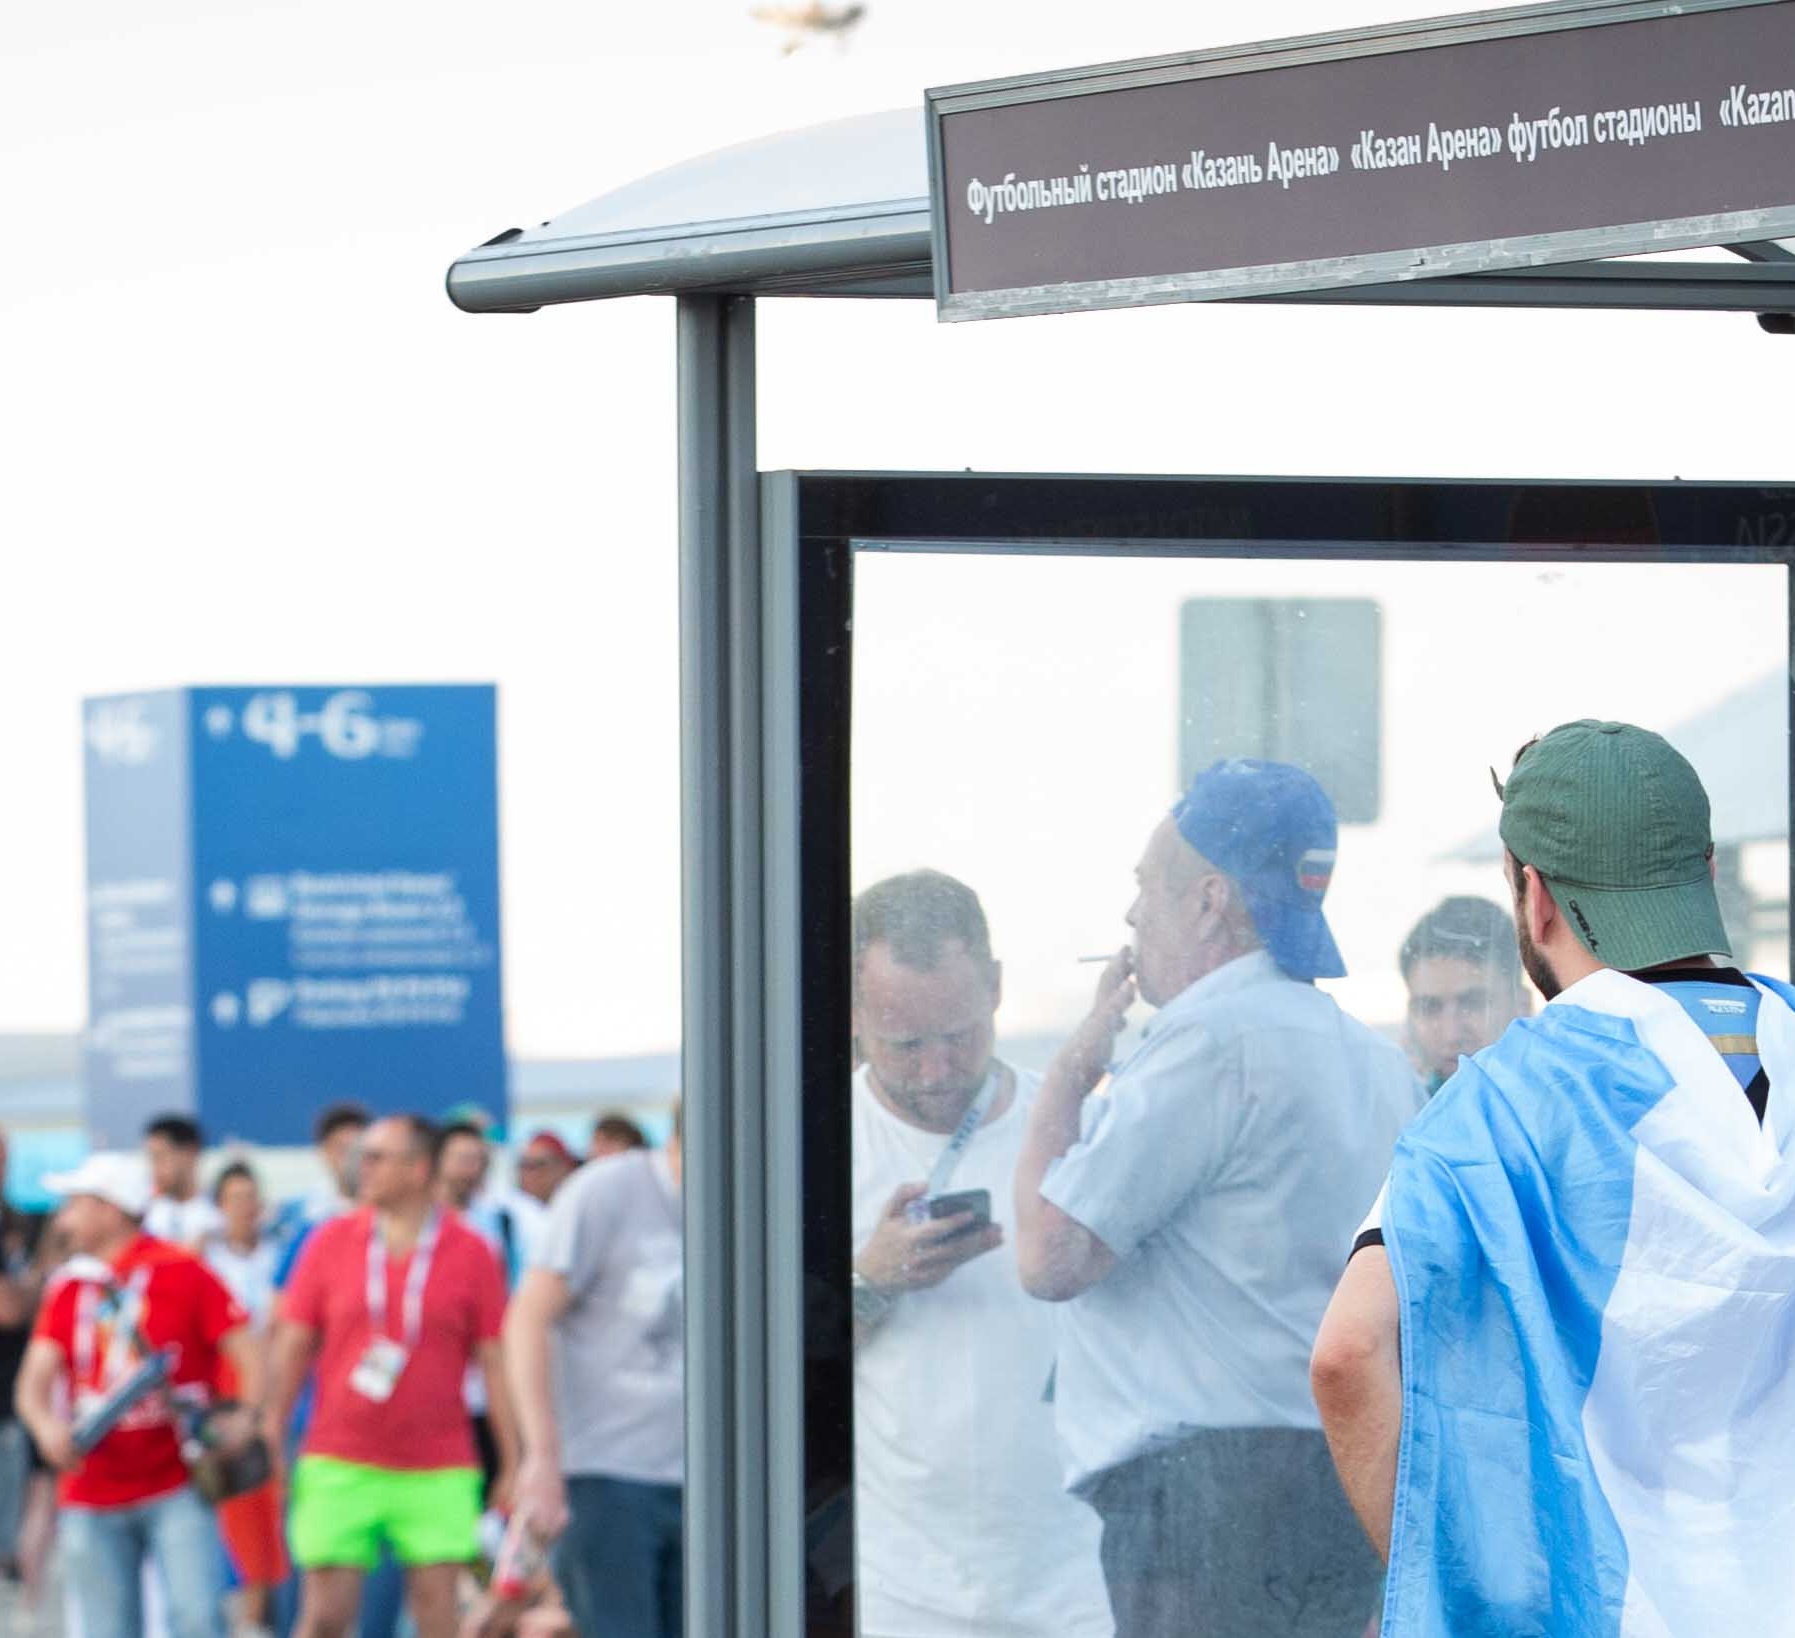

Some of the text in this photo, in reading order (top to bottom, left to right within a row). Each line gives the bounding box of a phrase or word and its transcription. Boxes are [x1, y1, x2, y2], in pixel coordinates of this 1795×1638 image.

[1350, 101, 1702, 171] «Казан Арена» футбол стадионы
[967, 141, 1340, 225] Футбольный стадион «Казань Арена»
